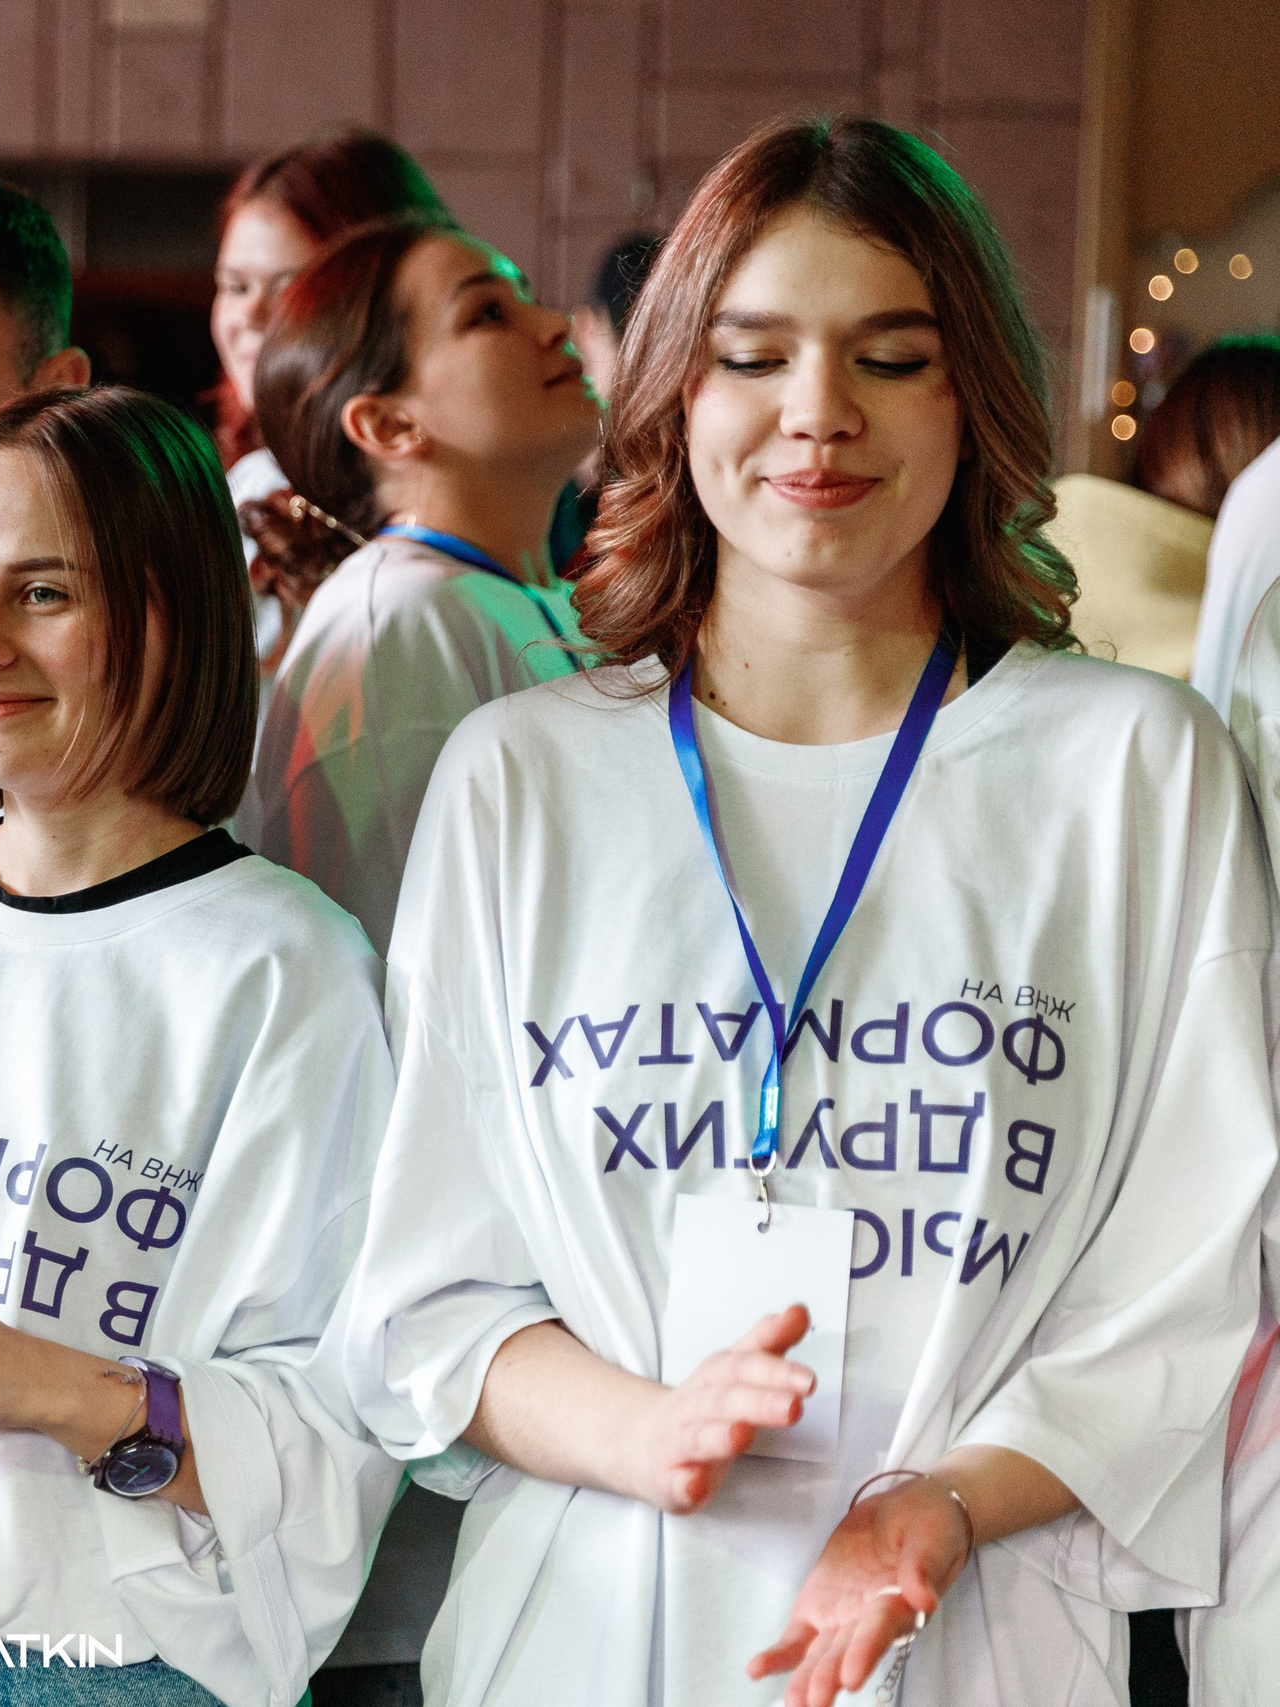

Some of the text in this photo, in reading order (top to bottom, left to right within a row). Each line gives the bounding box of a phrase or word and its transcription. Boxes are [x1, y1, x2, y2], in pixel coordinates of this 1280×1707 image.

[960, 978, 1076, 1023] НА ВНЖ
[522, 998, 1066, 1087] ФОРМАТАХ
[93, 1139, 204, 1194] НА ВНЖ
[1005, 1119, 1056, 1195] В
[99, 1281, 160, 1347] В
